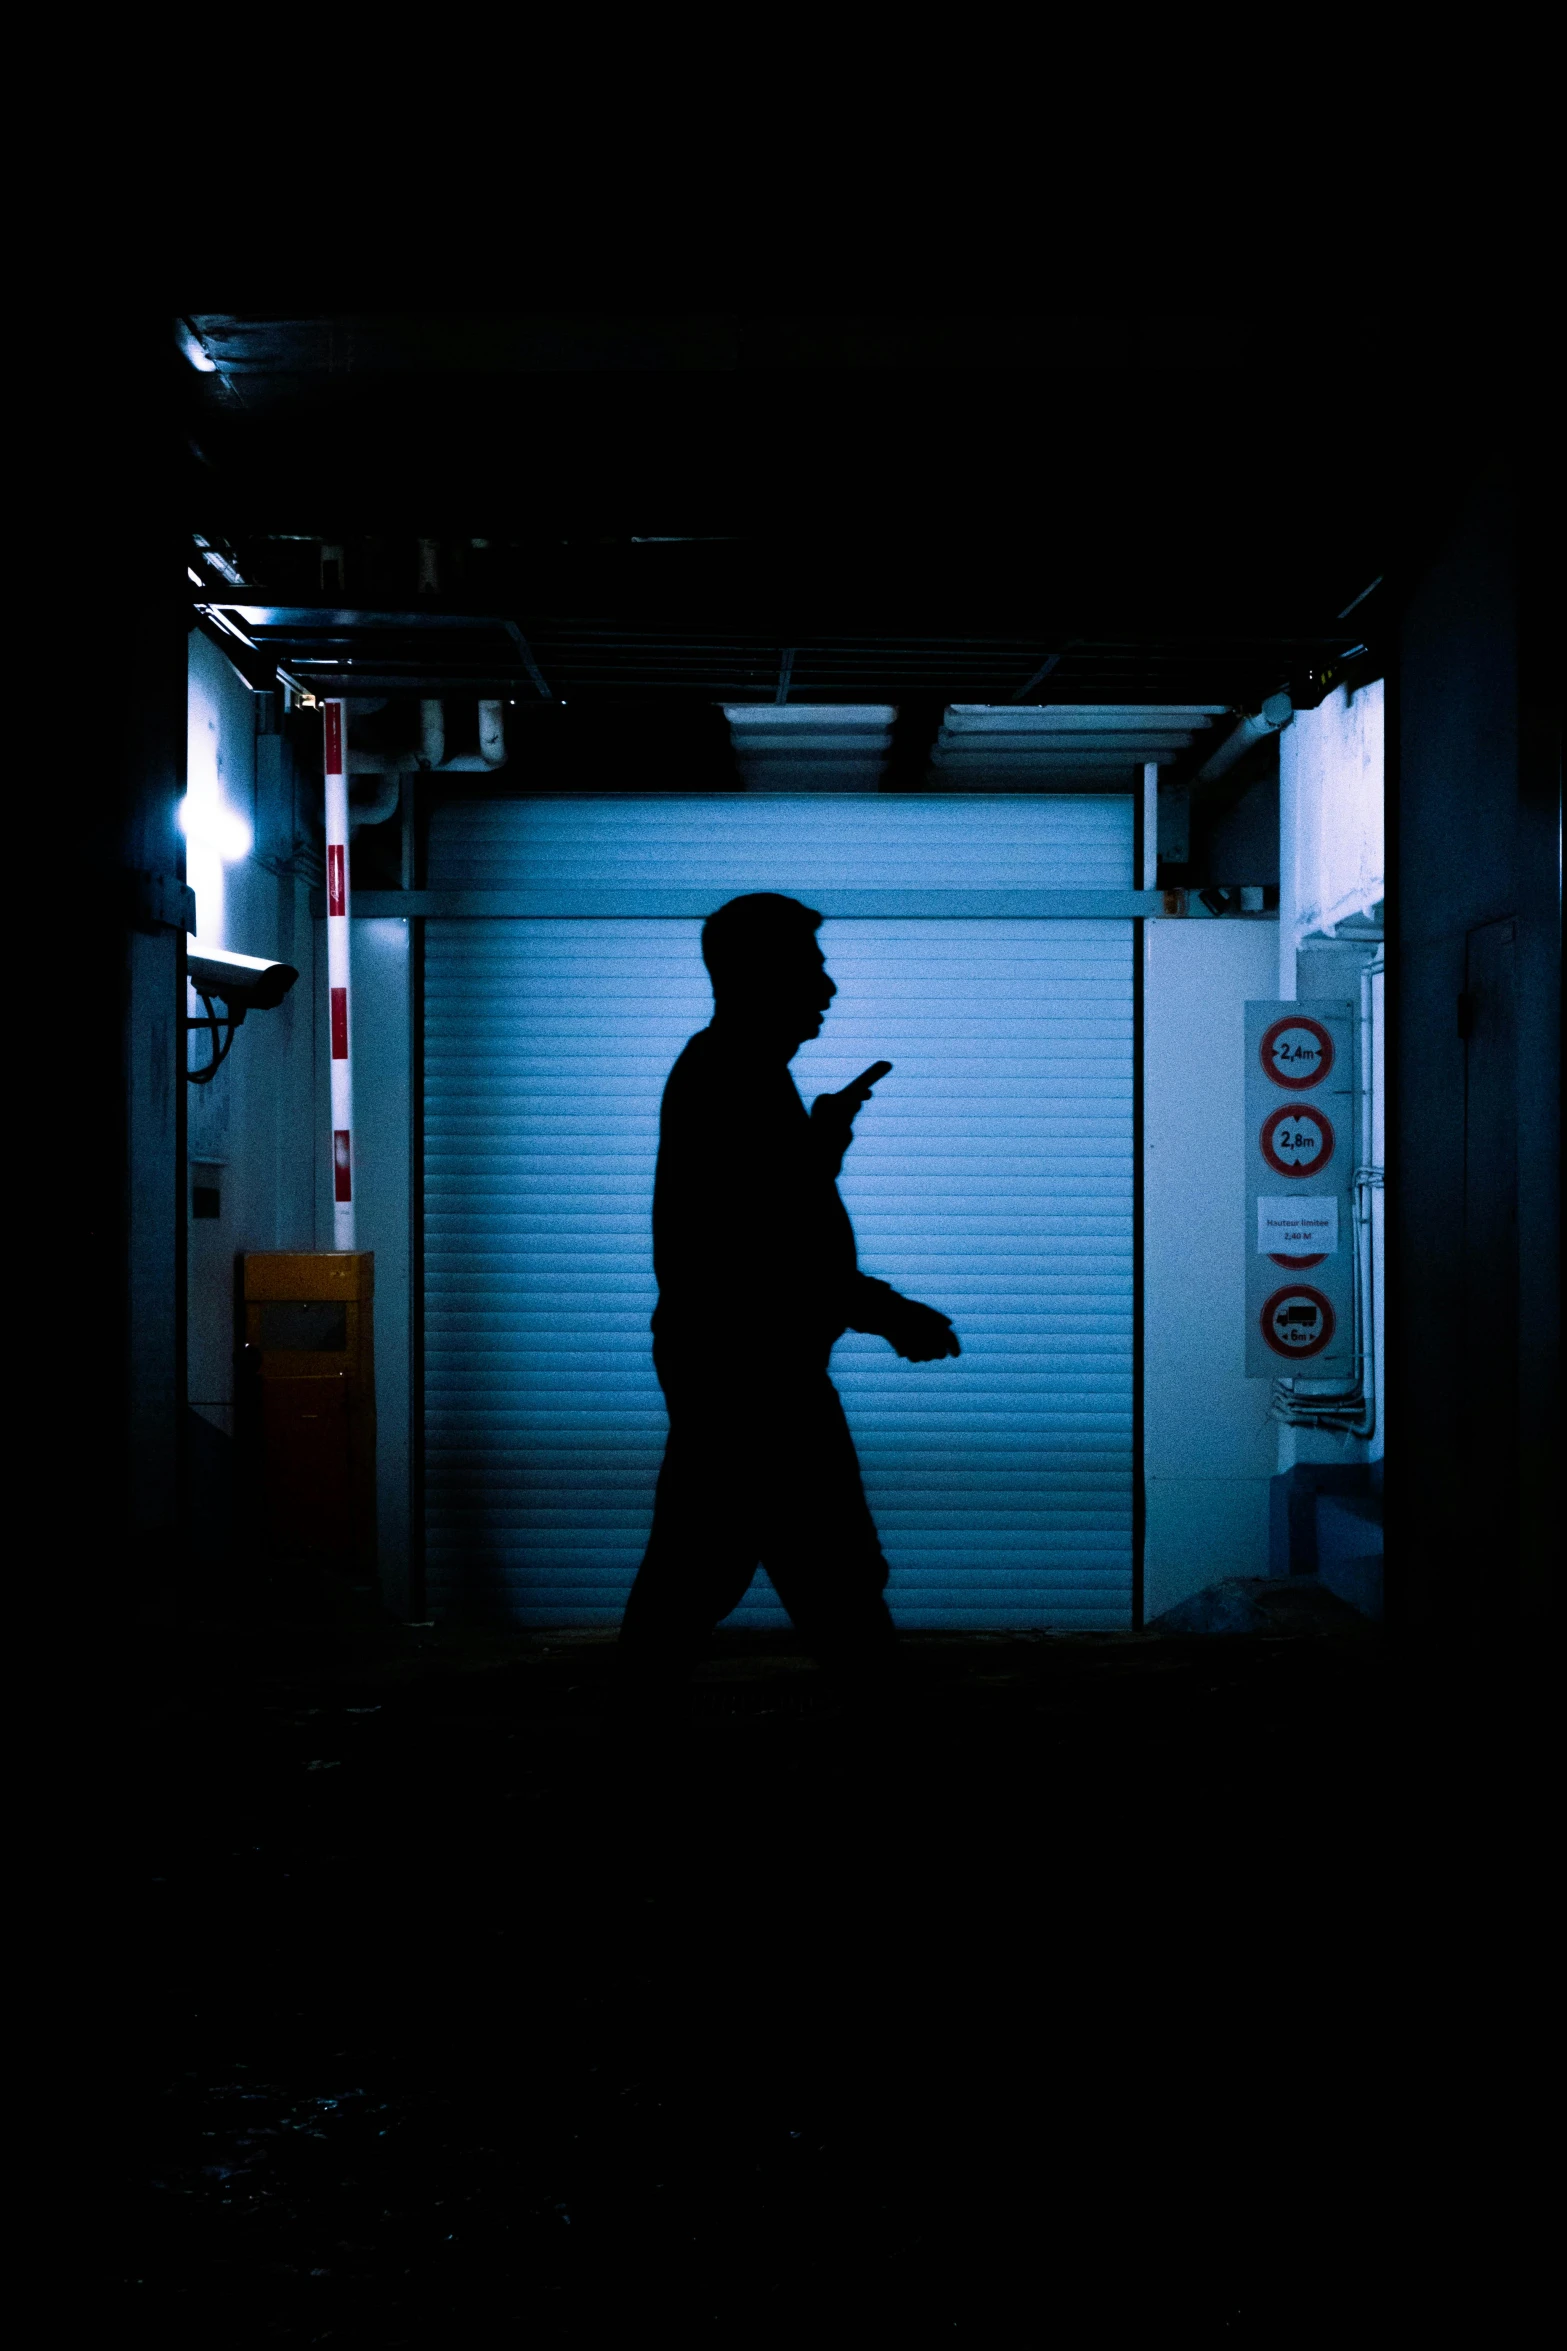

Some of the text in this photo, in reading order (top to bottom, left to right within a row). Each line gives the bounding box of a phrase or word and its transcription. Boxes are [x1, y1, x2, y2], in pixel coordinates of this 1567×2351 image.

[1281, 1043, 1314, 1061] 2,4m
[1281, 1131, 1314, 1149] 2,8m
[1267, 1219, 1299, 1227] Hauteur
[1291, 1329, 1307, 1341] 6m
